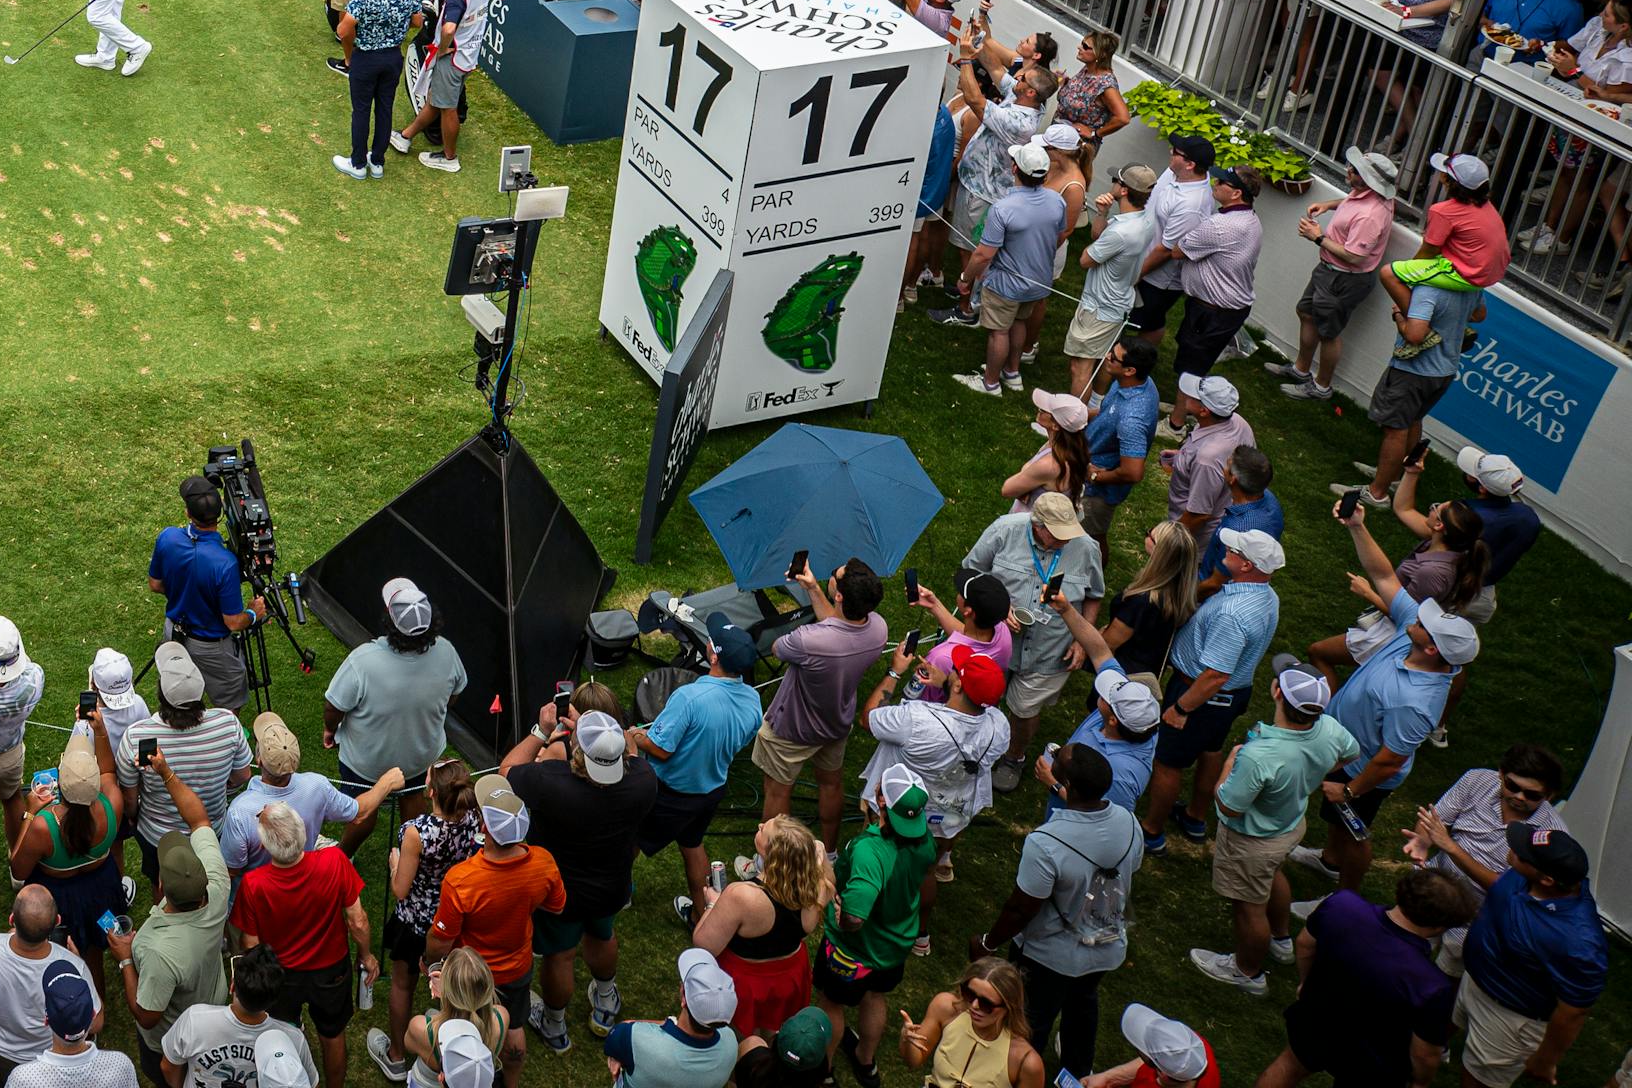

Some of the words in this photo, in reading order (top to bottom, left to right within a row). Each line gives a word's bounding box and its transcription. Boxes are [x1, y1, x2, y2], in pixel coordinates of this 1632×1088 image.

[694, 3, 889, 53] charles
[659, 22, 733, 137] 17
[788, 65, 909, 165] 17
[633, 107, 660, 142] PAR
[721, 188, 730, 205] 4
[630, 137, 672, 188] YARDS
[701, 205, 726, 238] 399
[751, 190, 794, 213] PAR
[897, 170, 910, 186] 4
[745, 217, 818, 245] YARDS
[868, 202, 905, 225] 399
[631, 329, 665, 377] FedEx
[764, 385, 820, 409] FedEx
[197, 1044, 257, 1069] EASTSID
